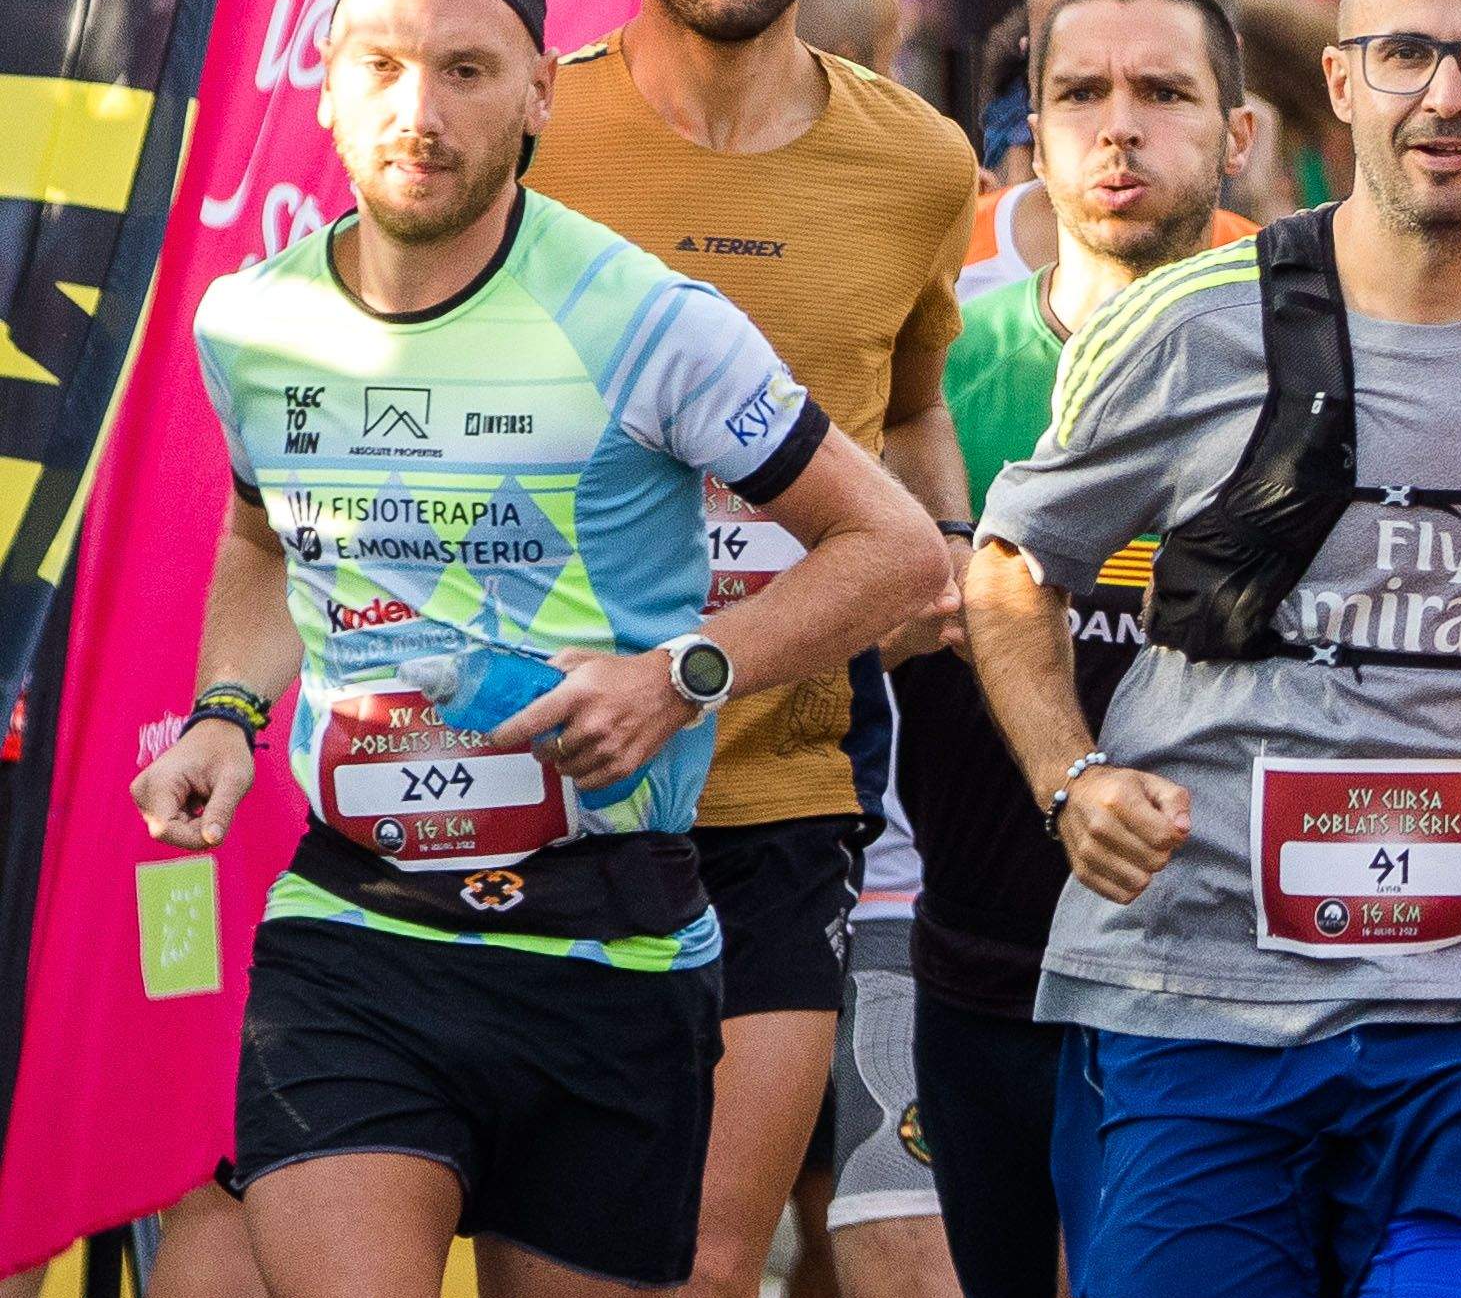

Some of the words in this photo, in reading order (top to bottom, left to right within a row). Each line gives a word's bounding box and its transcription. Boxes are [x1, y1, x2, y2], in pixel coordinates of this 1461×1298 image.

[702, 236, 787, 259] TERREX
[284, 386, 325, 408] FLEC
[286, 409, 306, 431] TO
[284, 432, 320, 454] MIN
[332, 497, 521, 526] FISIOTERAPIA
[336, 537, 544, 563] E.MONASTERIO
[717, 577, 745, 596] KM
[389, 707, 411, 728] XV
[351, 732, 431, 754] POBLATS
[439, 729, 491, 749] IBER
[401, 762, 474, 801] 209
[1347, 789, 1372, 810] XV
[1381, 788, 1442, 811] CURSA
[446, 818, 476, 837] KM
[1303, 813, 1390, 834] POBLATS
[1369, 847, 1409, 884] 91
[1361, 903, 1382, 924] 16
[1392, 903, 1421, 923] KM
